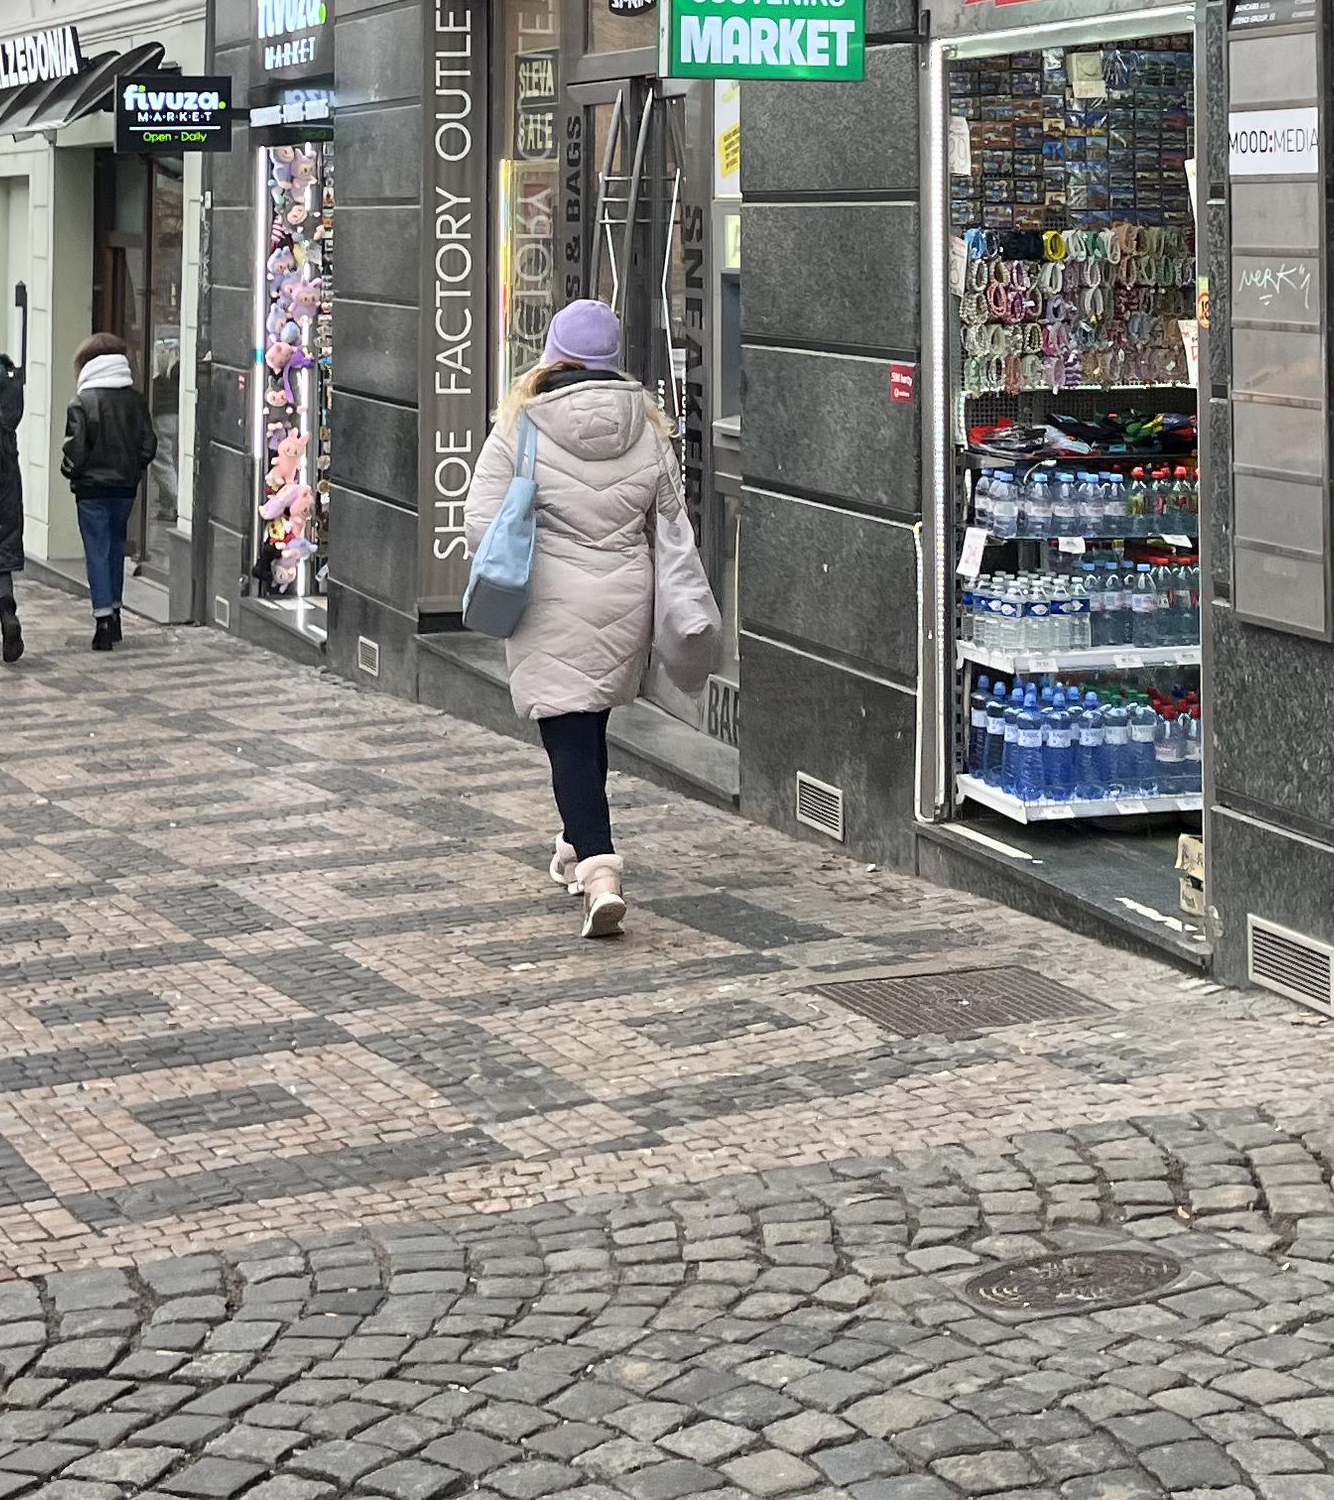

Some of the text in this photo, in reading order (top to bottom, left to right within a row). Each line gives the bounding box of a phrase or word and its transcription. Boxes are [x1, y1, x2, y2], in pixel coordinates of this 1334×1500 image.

[680, 15, 855, 66] MARKET
[519, 60, 555, 99] SLEVA
[143, 132, 172, 143] Open
[181, 132, 207, 143] Daily
[519, 112, 554, 150] SALE
[567, 115, 582, 222] BAGS
[435, 186, 472, 395] FACTORY
[434, 430, 472, 561] SHOE
